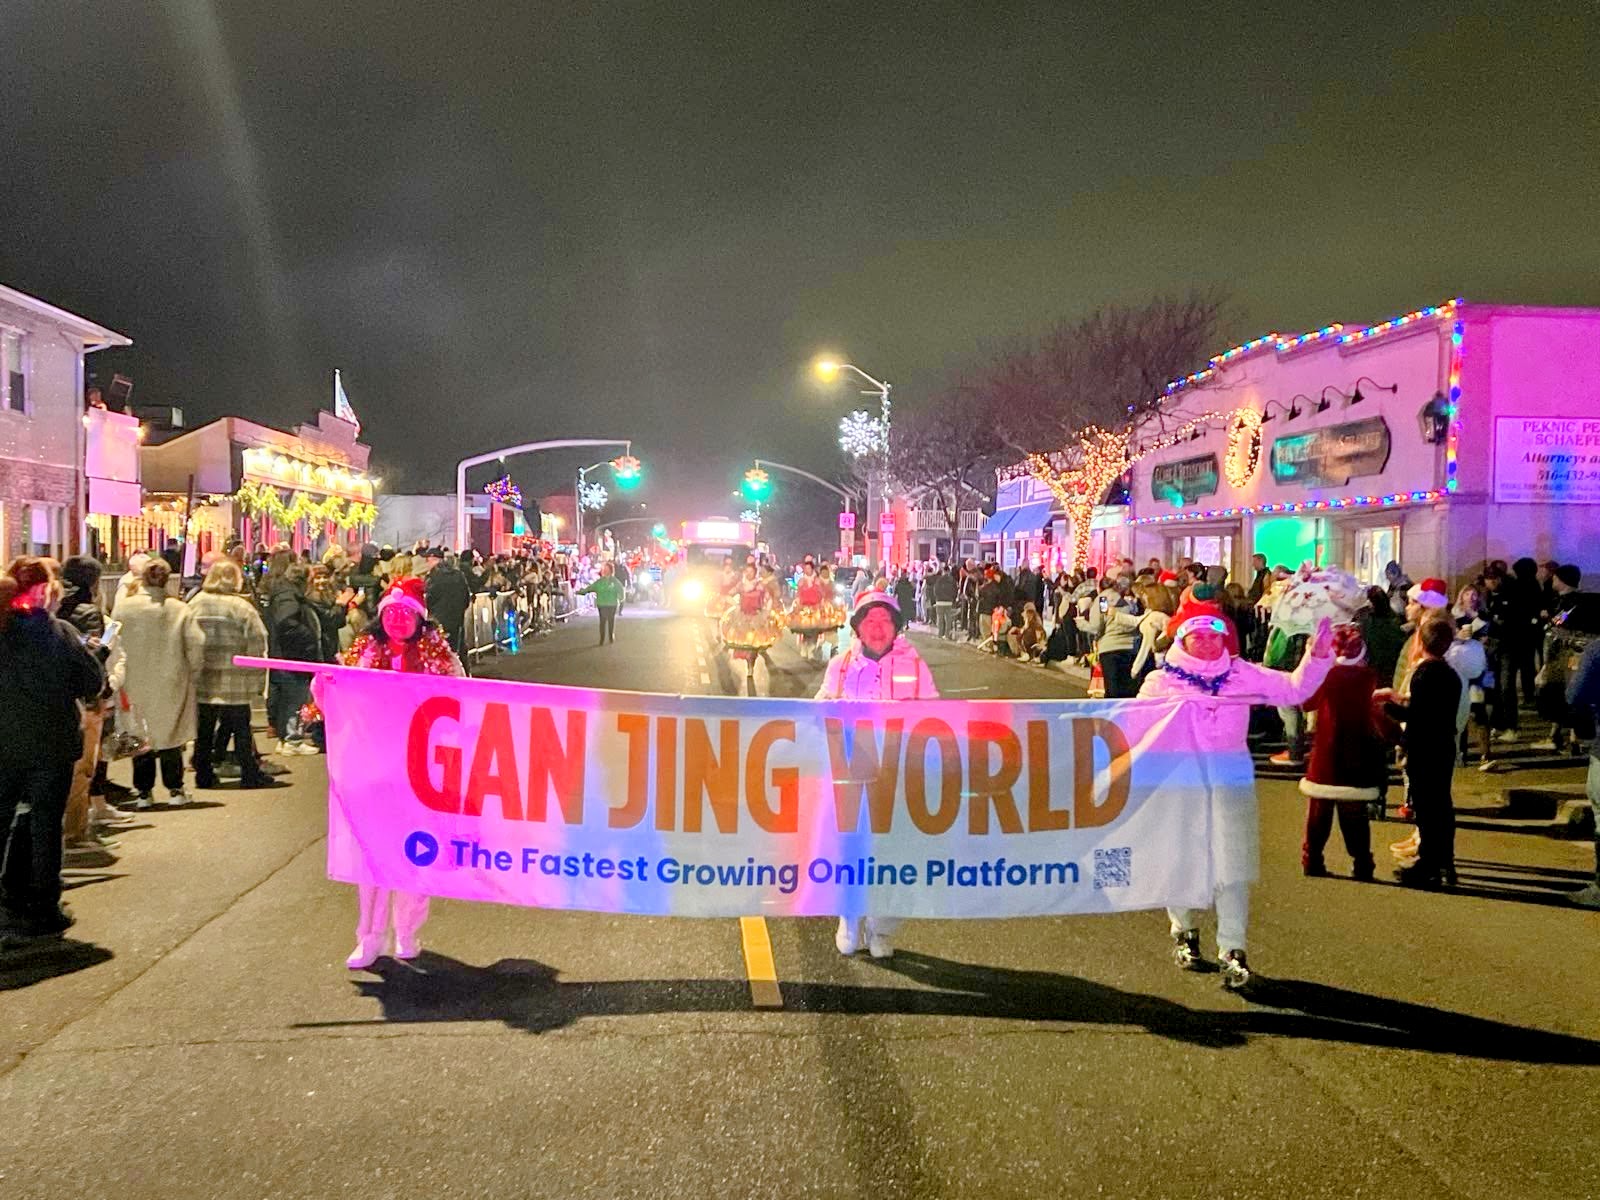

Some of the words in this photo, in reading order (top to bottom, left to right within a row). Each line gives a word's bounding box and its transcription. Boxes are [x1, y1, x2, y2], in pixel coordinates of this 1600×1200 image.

[1521, 452, 1586, 465] Attorneys
[407, 696, 587, 825] GAN
[608, 713, 799, 834] JING
[825, 717, 1132, 836] WORLD
[450, 840, 513, 873] The
[522, 848, 648, 882] Fastest
[657, 857, 799, 894] Growing
[808, 857, 918, 886] Online
[926, 857, 1080, 887] Platform
